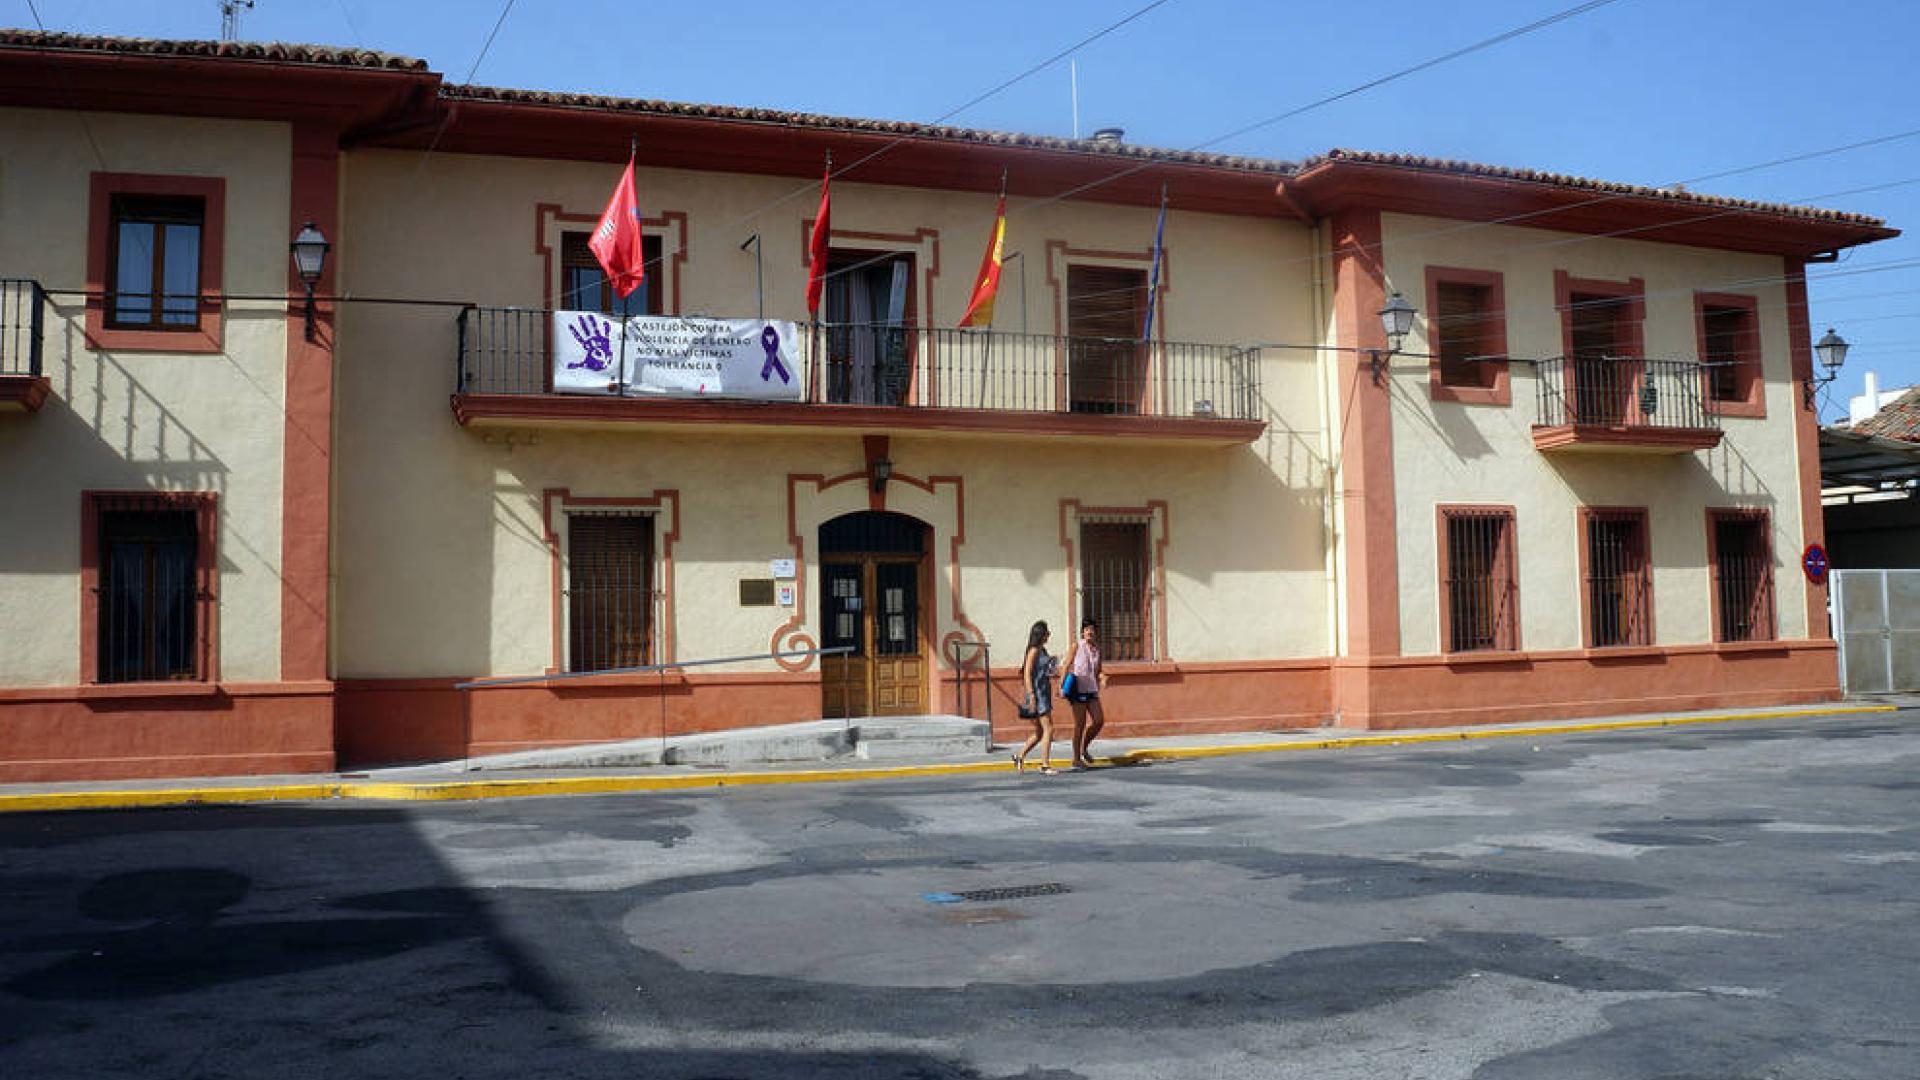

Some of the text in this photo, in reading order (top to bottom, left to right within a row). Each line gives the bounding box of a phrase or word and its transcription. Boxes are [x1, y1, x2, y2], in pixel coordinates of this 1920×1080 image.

[690, 324, 731, 333] CONTRA
[634, 335, 688, 345] VIOLENCIA
[691, 337, 705, 346] DE
[637, 347, 652, 355] NO
[648, 359, 712, 370] TOLERANCIA
